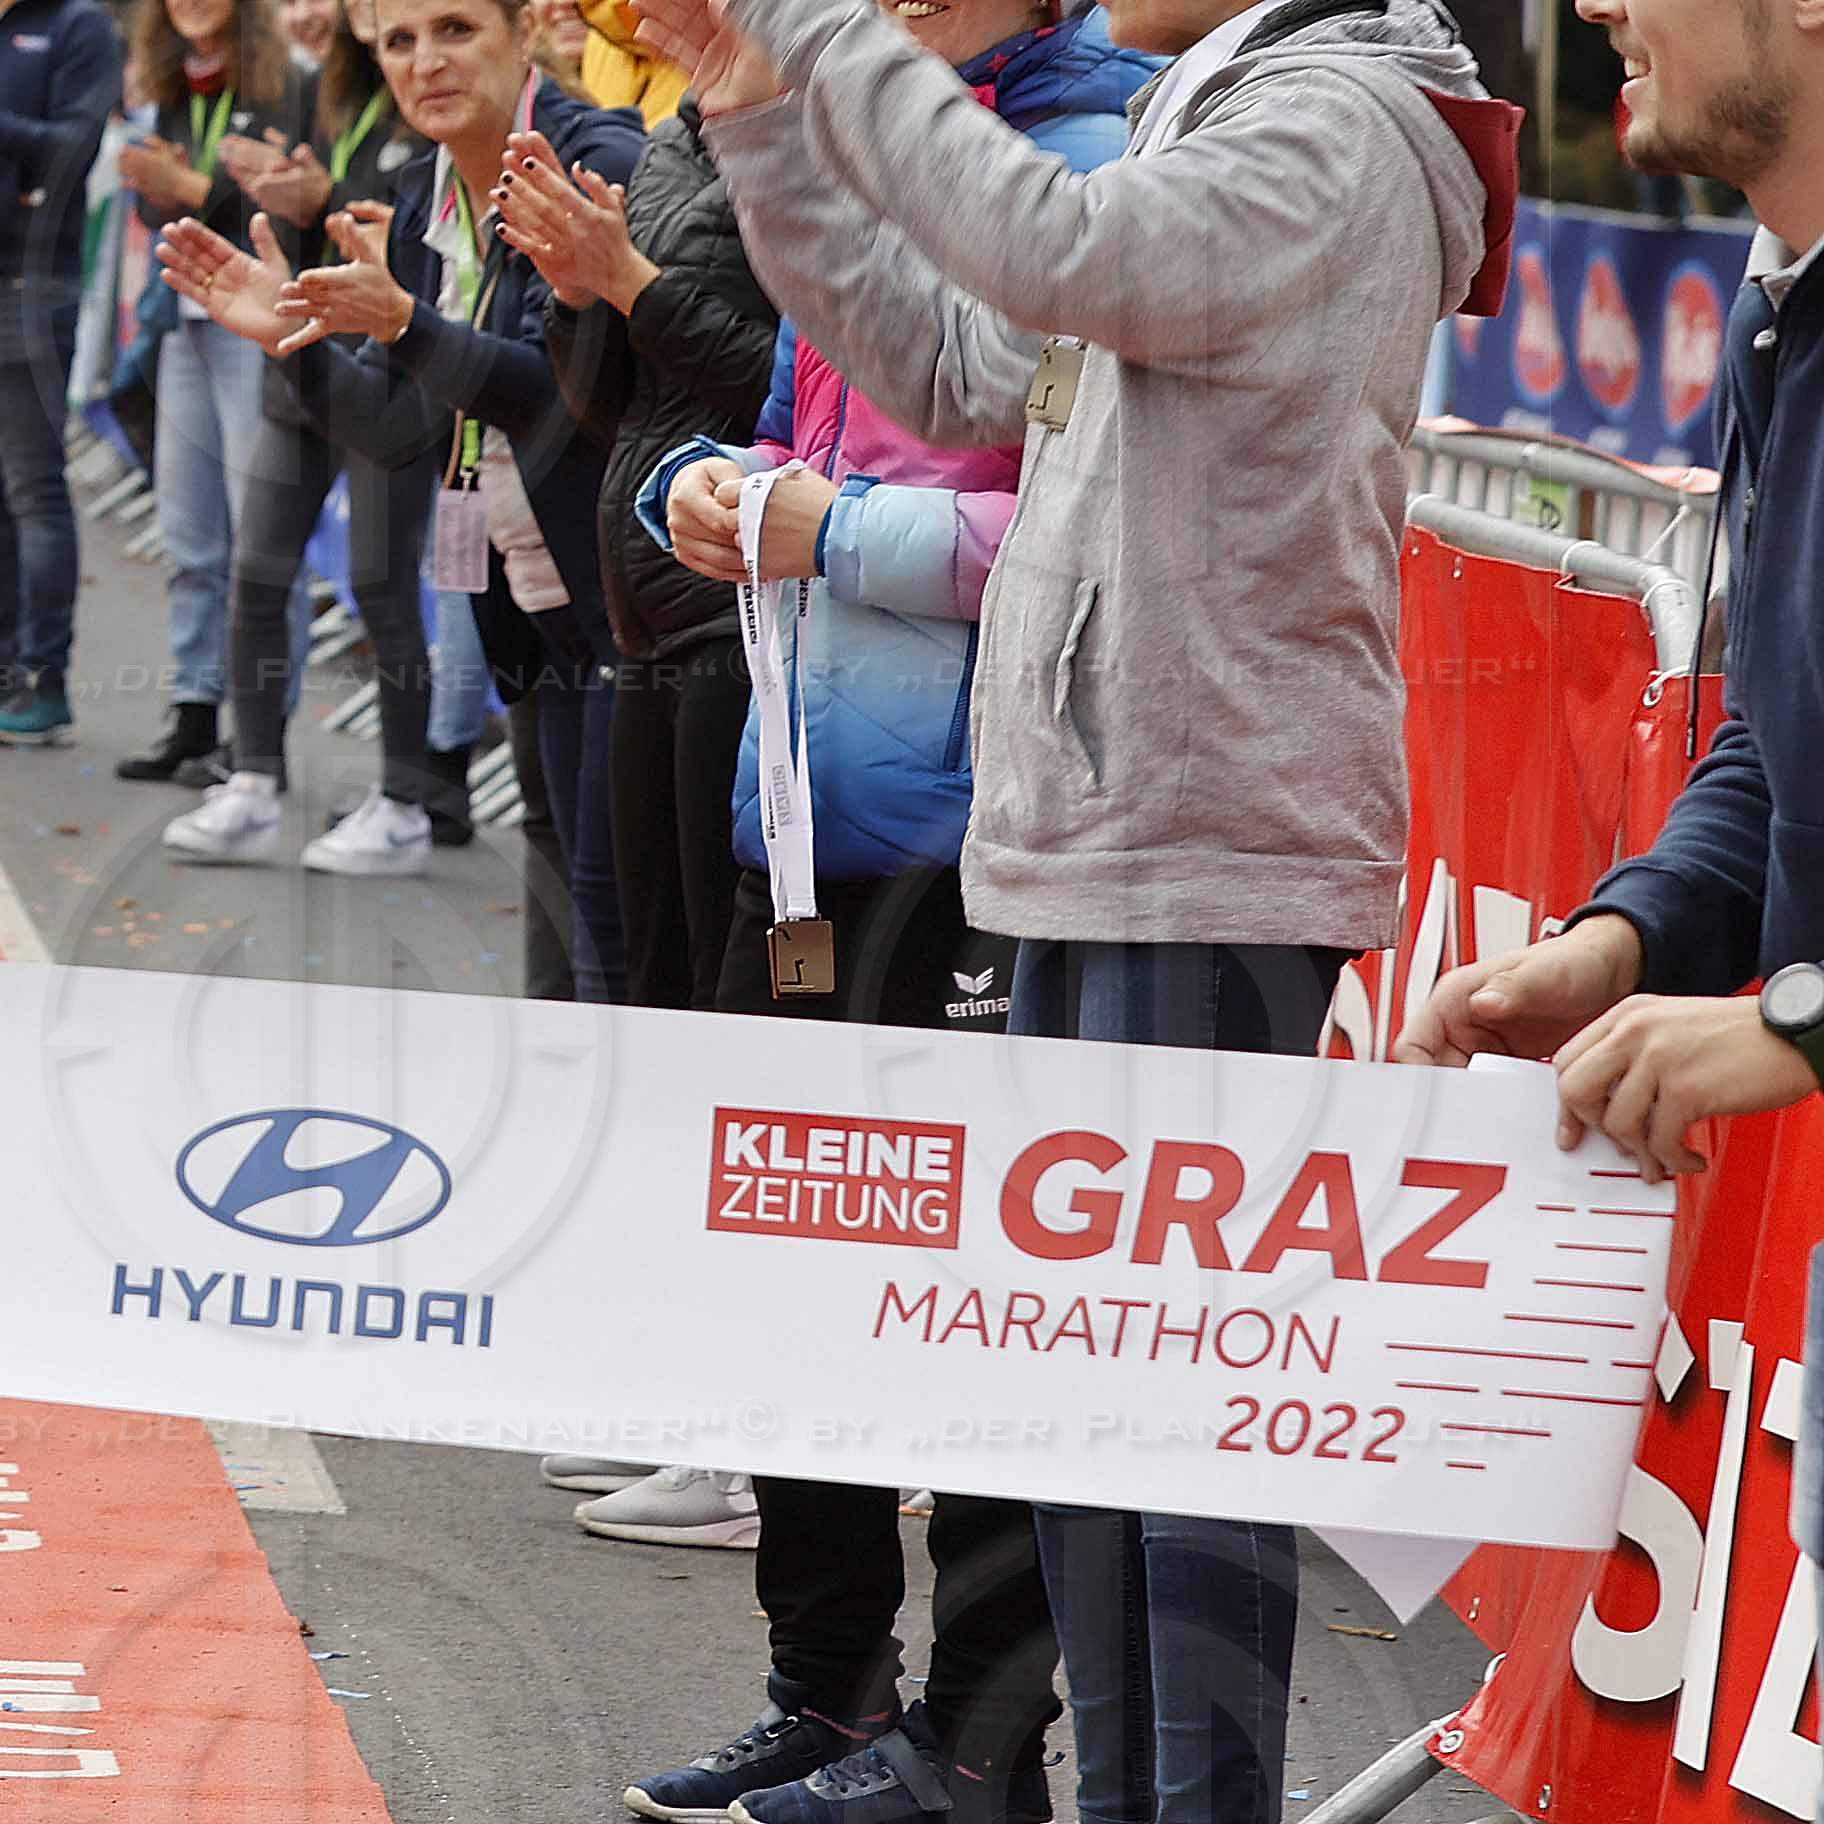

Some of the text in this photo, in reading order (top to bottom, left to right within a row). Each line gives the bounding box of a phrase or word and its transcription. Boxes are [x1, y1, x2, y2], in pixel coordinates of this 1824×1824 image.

[945, 991, 1011, 1021] erima
[718, 1182, 949, 1237] ZEITUNG
[721, 1121, 1509, 1289] KLEINE GRAZ
[109, 1262, 497, 1350] HYUNDAI
[871, 1282, 1342, 1376] MARATHON
[1216, 1395, 1406, 1467] 2022
